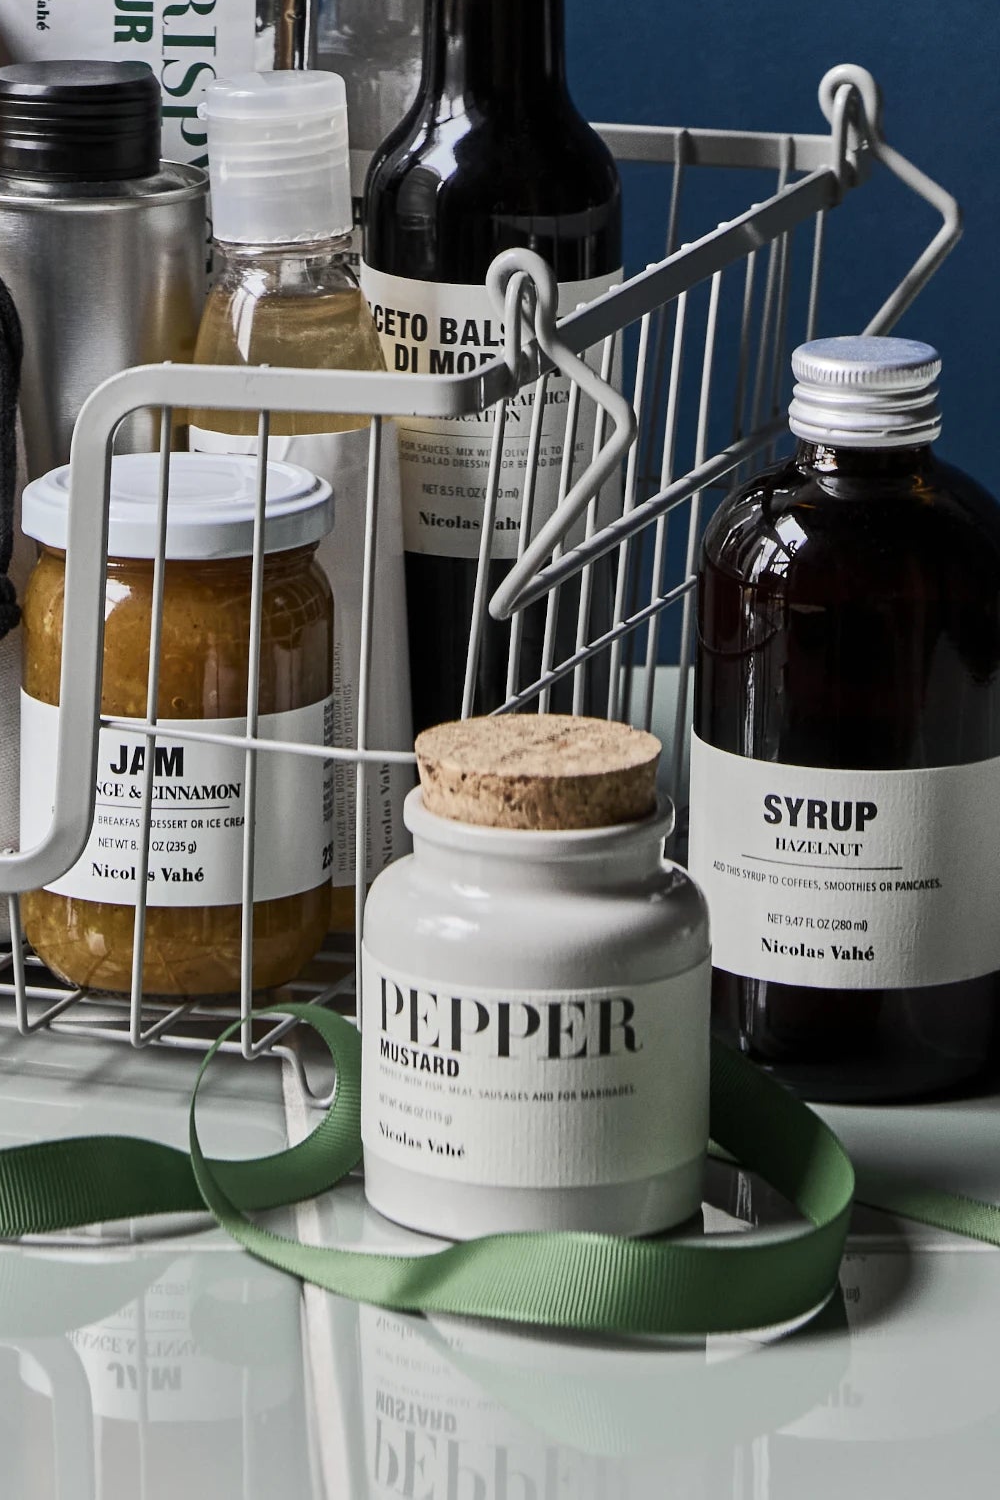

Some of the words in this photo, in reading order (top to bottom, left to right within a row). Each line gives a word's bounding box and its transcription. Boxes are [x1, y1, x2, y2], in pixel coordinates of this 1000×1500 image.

[368, 301, 428, 342] CETO
[395, 343, 418, 373] DI
[421, 455, 450, 467] SALAD
[453, 459, 491, 469] DRESSIN
[456, 447, 474, 457] MIX
[477, 448, 493, 457] WI
[551, 445, 561, 454] TO
[423, 483, 437, 494] NET
[456, 486, 465, 496] FL
[467, 487, 481, 498] OZ
[505, 487, 519, 500] ml)
[419, 511, 480, 530] Nicolas
[110, 745, 184, 777] JAM
[336, 763, 345, 792] BOOST
[346, 768, 354, 788] AND
[379, 762, 391, 795] Vah
[129, 787, 142, 799] &
[98, 815, 140, 828] BREAKFAS
[151, 819, 187, 829] DESSERT
[191, 819, 204, 829] OR
[206, 817, 221, 828] ICE
[224, 816, 246, 828] CREA
[764, 794, 878, 832] SYRUP
[381, 799, 393, 864] Nicolas
[98, 837, 115, 848] NET
[115, 839, 130, 850] WT
[152, 841, 165, 851] OZ
[166, 841, 185, 853] (235
[188, 841, 198, 854] g)
[775, 837, 863, 857] HAZELNUT
[92, 863, 155, 881] Nicols
[161, 867, 205, 882] Vahé
[713, 861, 726, 872] ADD
[727, 864, 741, 877] THIS
[742, 869, 767, 882] SYRUP
[769, 875, 779, 885] TO
[781, 877, 822, 891] COFFEES,
[824, 881, 877, 892] SMOOTHIES
[880, 882, 893, 892] OR
[895, 878, 943, 891] PANCAKES.
[767, 913, 783, 925] NET
[785, 915, 804, 927] 9.47
[806, 918, 815, 928] FL
[817, 918, 830, 930] OZ
[831, 919, 852, 932] (280
[854, 920, 868, 933] ml)
[761, 937, 825, 959] Nicolas
[831, 945, 875, 961] Vahé
[378, 973, 643, 1060] PEPPER
[380, 1038, 460, 1077] MUSTARD
[405, 1074, 422, 1086] WITH
[479, 1089, 529, 1102] SAUSAGES
[532, 1092, 554, 1102] AND
[558, 1091, 577, 1101] FOR
[379, 1120, 422, 1148] Nicolas
[428, 1138, 465, 1158] Vahé
